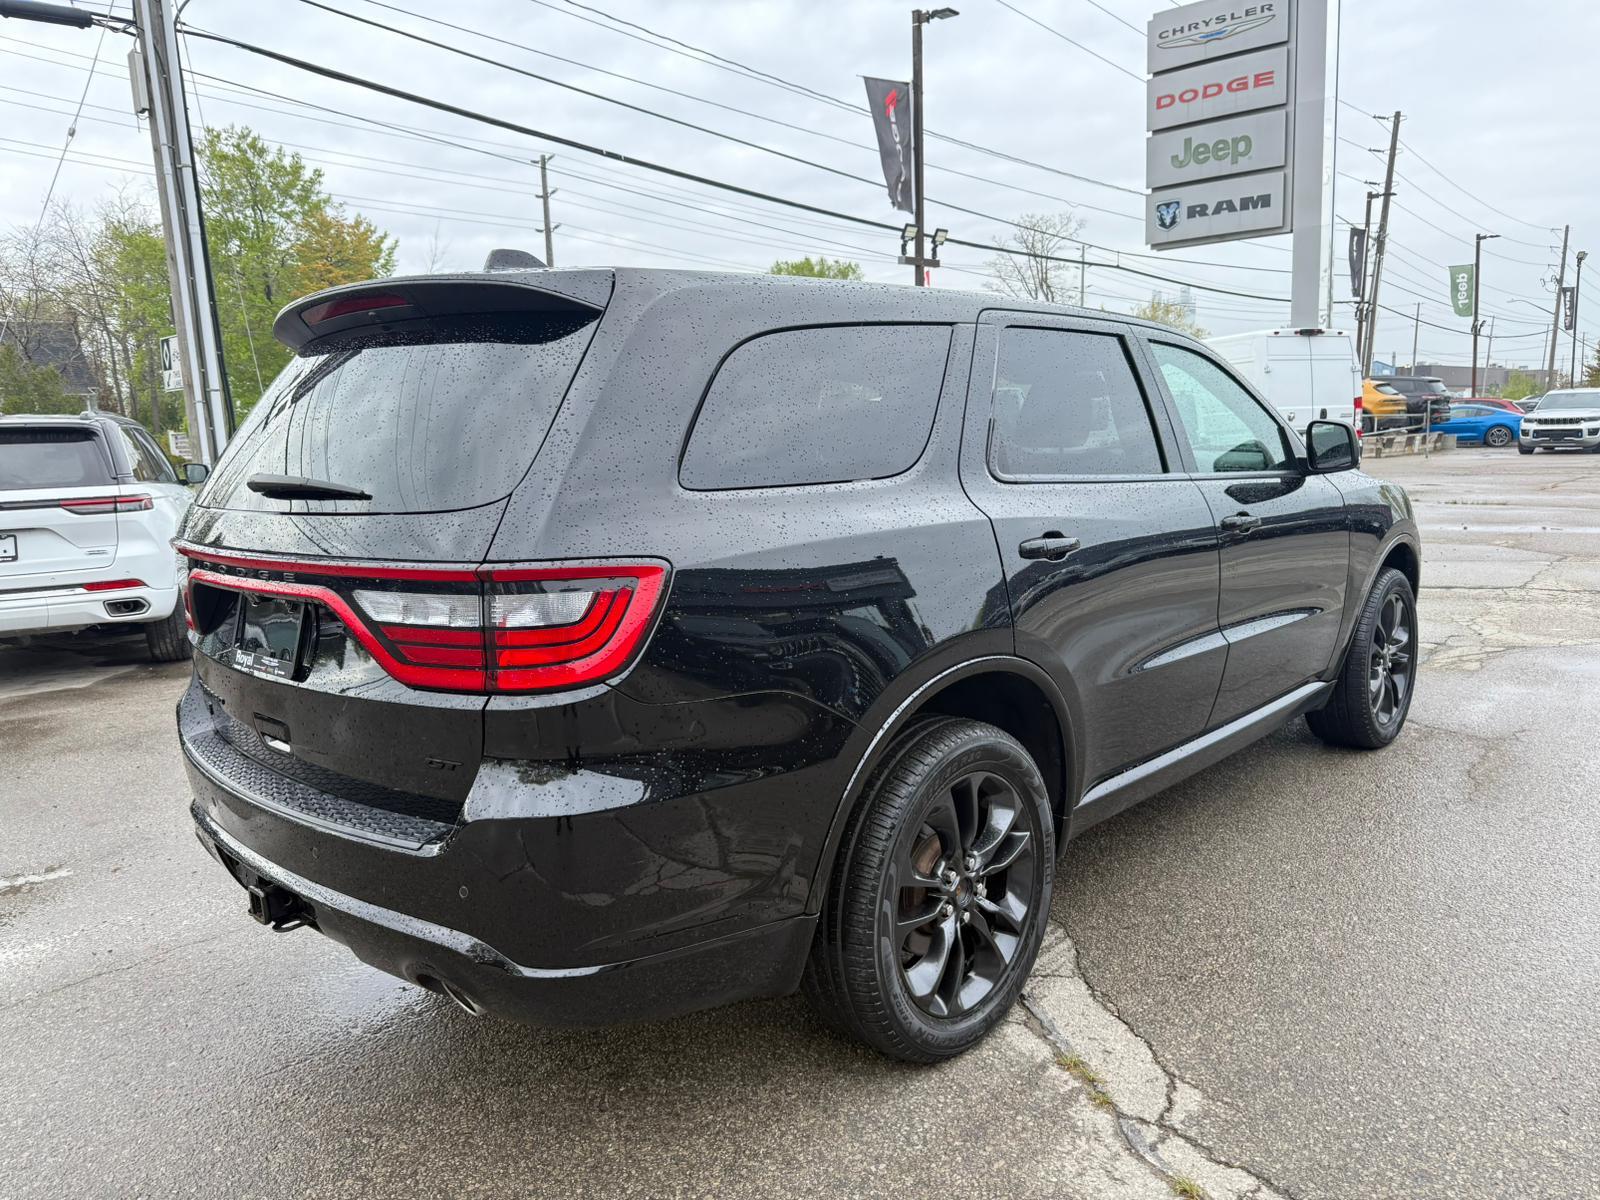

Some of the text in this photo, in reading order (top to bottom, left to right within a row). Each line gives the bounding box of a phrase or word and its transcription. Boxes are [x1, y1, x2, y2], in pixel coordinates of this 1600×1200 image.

[1158, 3, 1274, 40] CHRYSLER
[1155, 70, 1275, 110] DODGE
[1170, 133, 1252, 169] Jeep
[1187, 193, 1272, 219] RAM
[203, 561, 296, 583] DODGE
[235, 649, 255, 667] Royal
